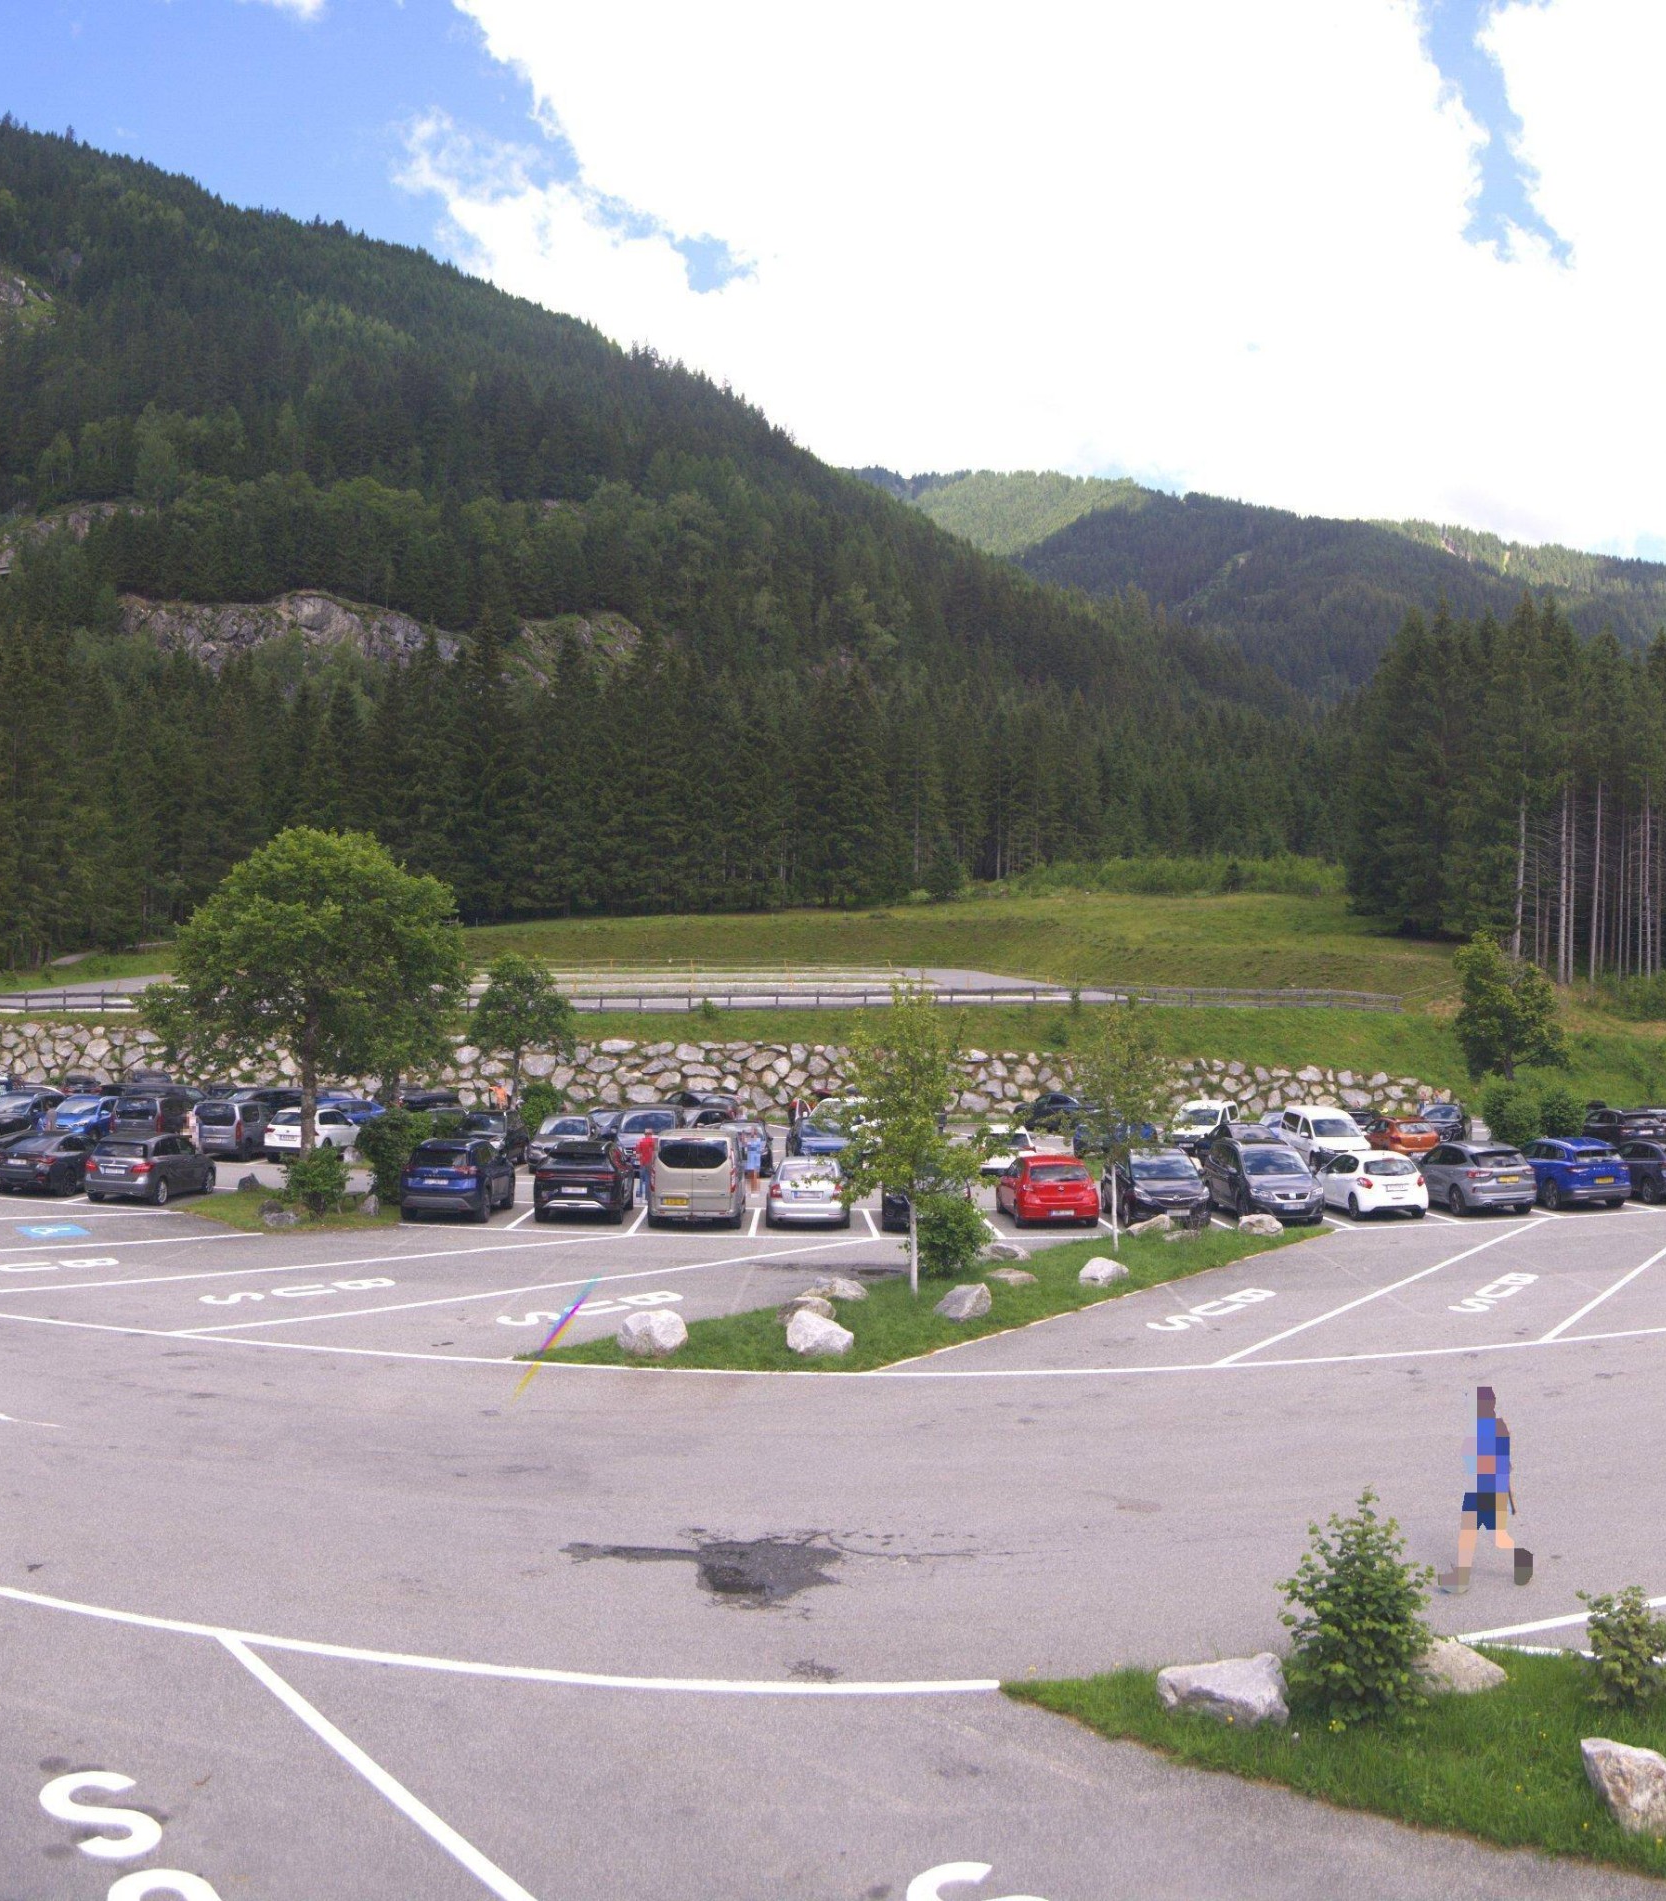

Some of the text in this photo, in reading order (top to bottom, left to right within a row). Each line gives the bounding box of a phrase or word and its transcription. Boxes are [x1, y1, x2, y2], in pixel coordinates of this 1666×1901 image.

[199, 1277, 396, 1305] BUS
[495, 1290, 684, 1327] BUS
[1145, 1287, 1277, 1331] BUS
[1447, 1272, 1539, 1313] BUS
